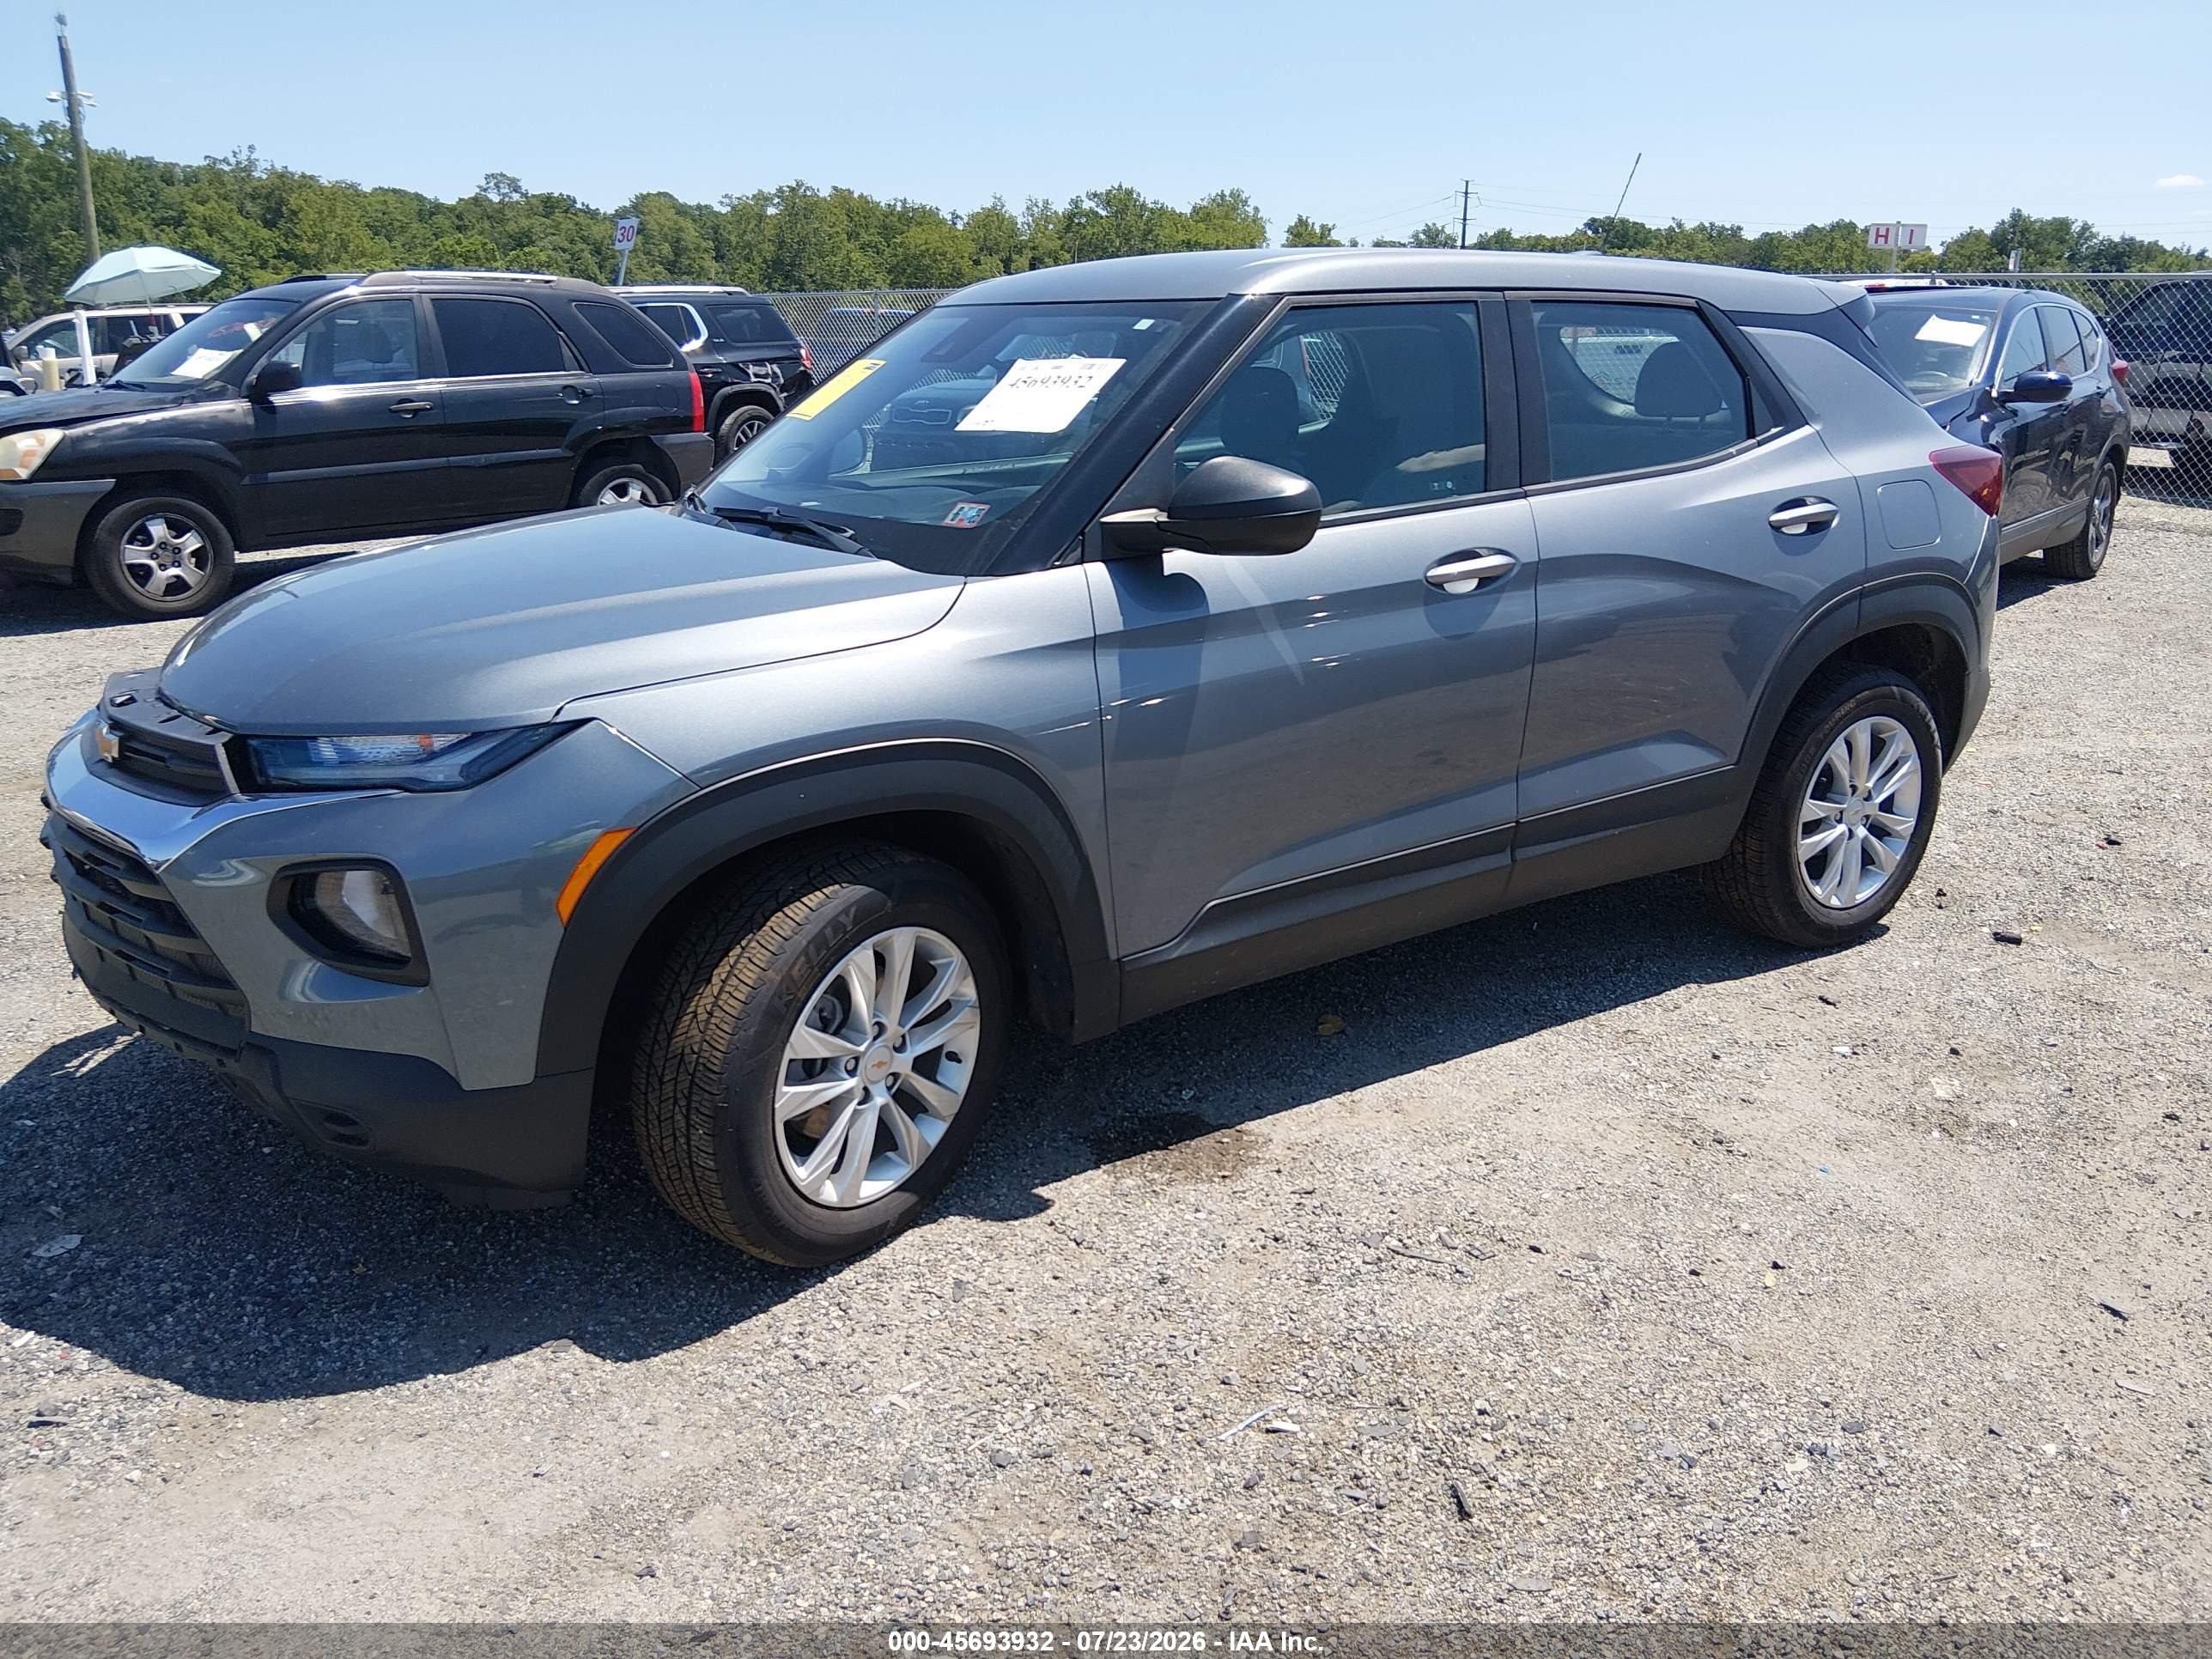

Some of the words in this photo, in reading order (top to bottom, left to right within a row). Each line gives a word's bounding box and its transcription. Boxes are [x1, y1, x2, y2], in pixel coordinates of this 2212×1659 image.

[617, 225, 635, 243] 30
[1875, 227, 1890, 245] H
[773, 904, 857, 1012] KELLY
